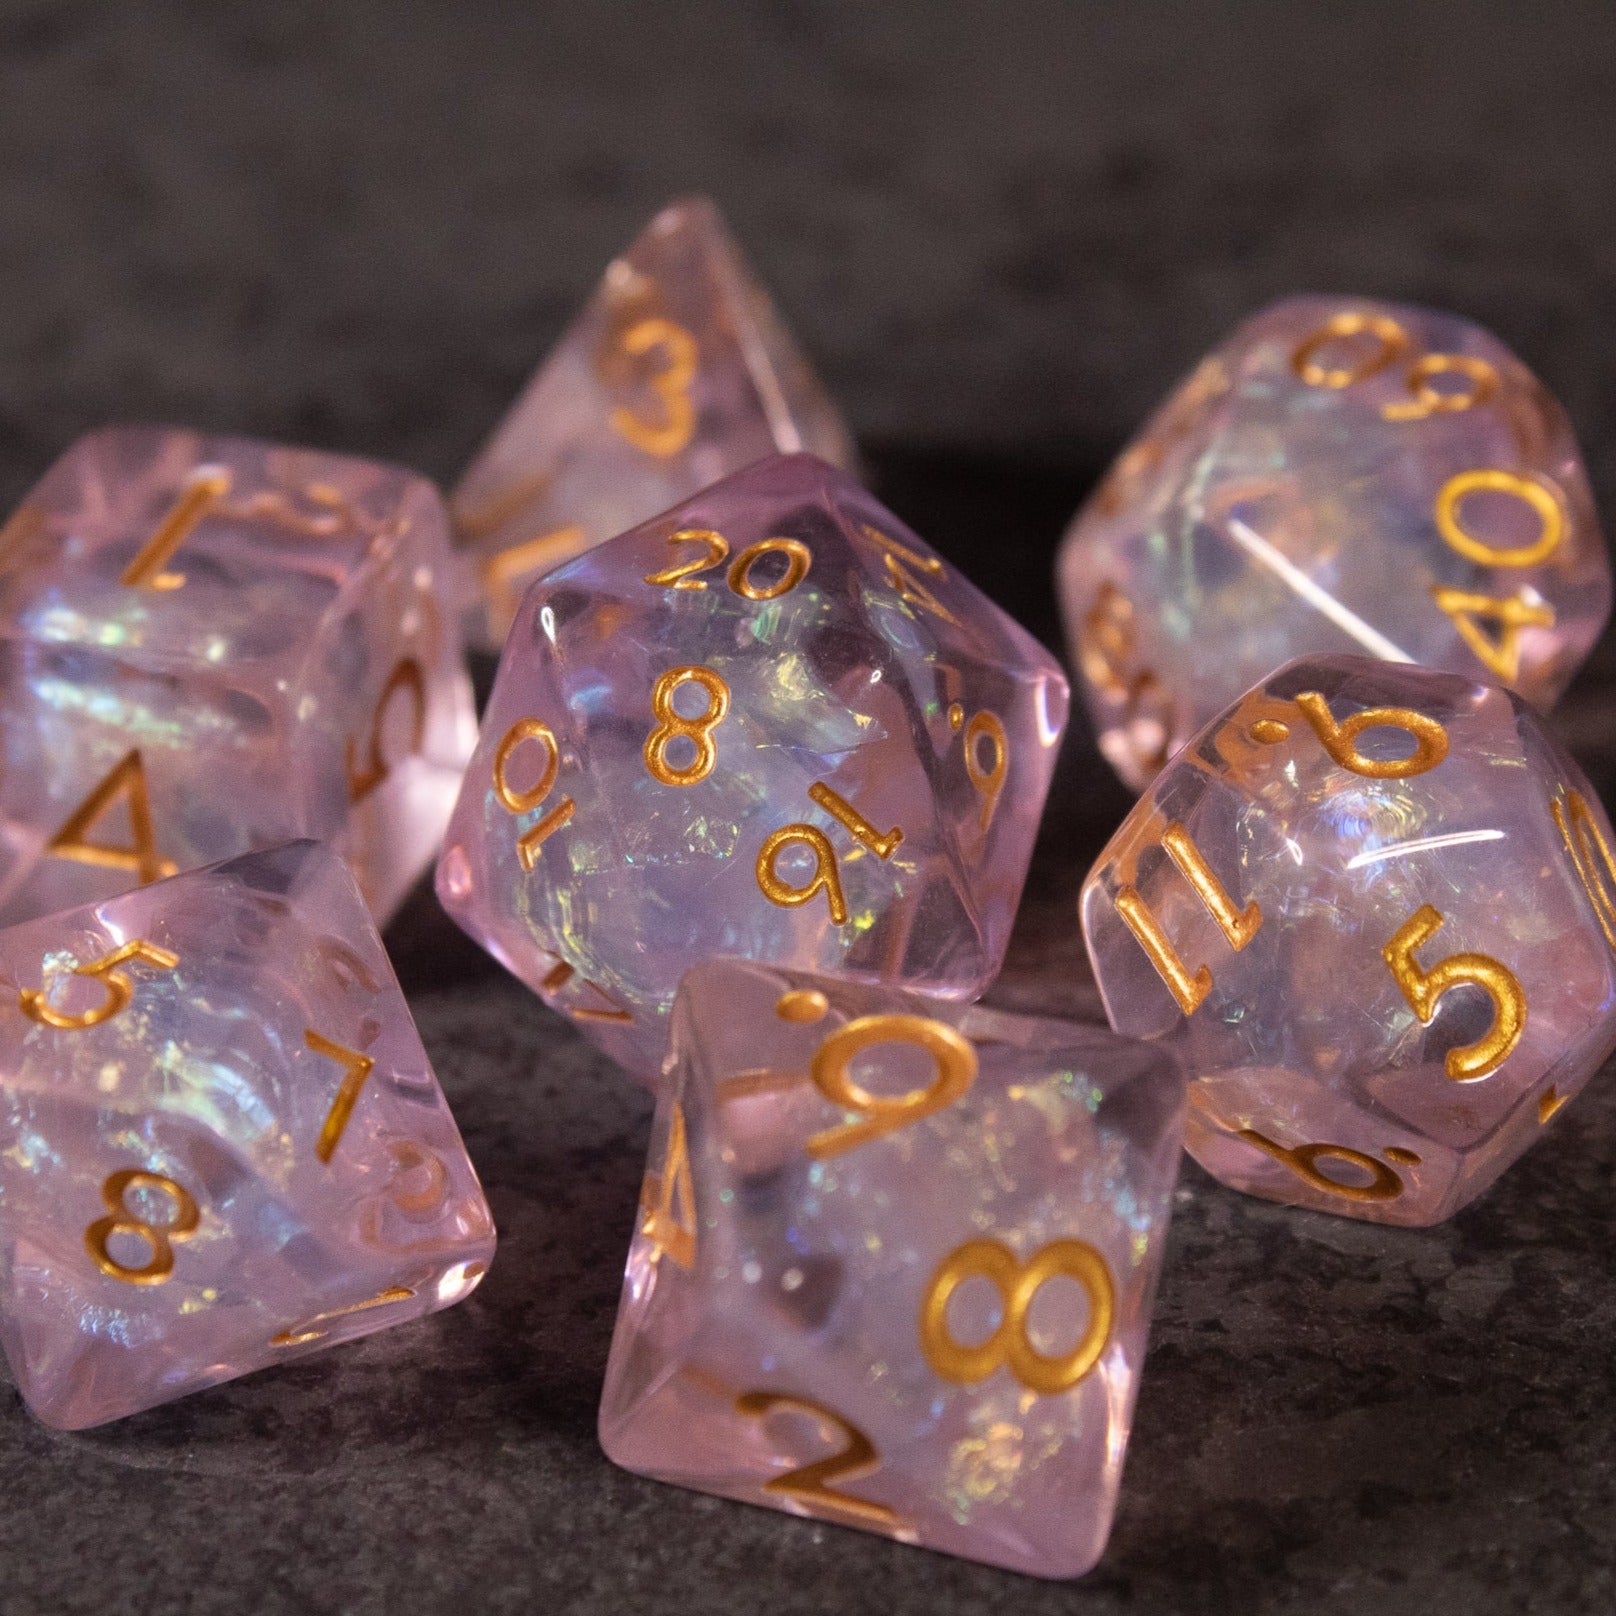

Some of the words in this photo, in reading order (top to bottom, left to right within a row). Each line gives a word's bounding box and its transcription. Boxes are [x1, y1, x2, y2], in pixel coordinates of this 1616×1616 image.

[614, 318, 699, 460] 3
[646, 528, 812, 600] 20
[492, 716, 577, 872] 10
[642, 665, 730, 787] 8
[48, 748, 178, 887] 4
[1114, 821, 1263, 1017] 11
[1381, 903, 1528, 1082] 5
[304, 1028, 374, 1165] 7
[84, 1169, 201, 1286] 8
[919, 1237, 1117, 1395] 8
[733, 1390, 906, 1528] 2
